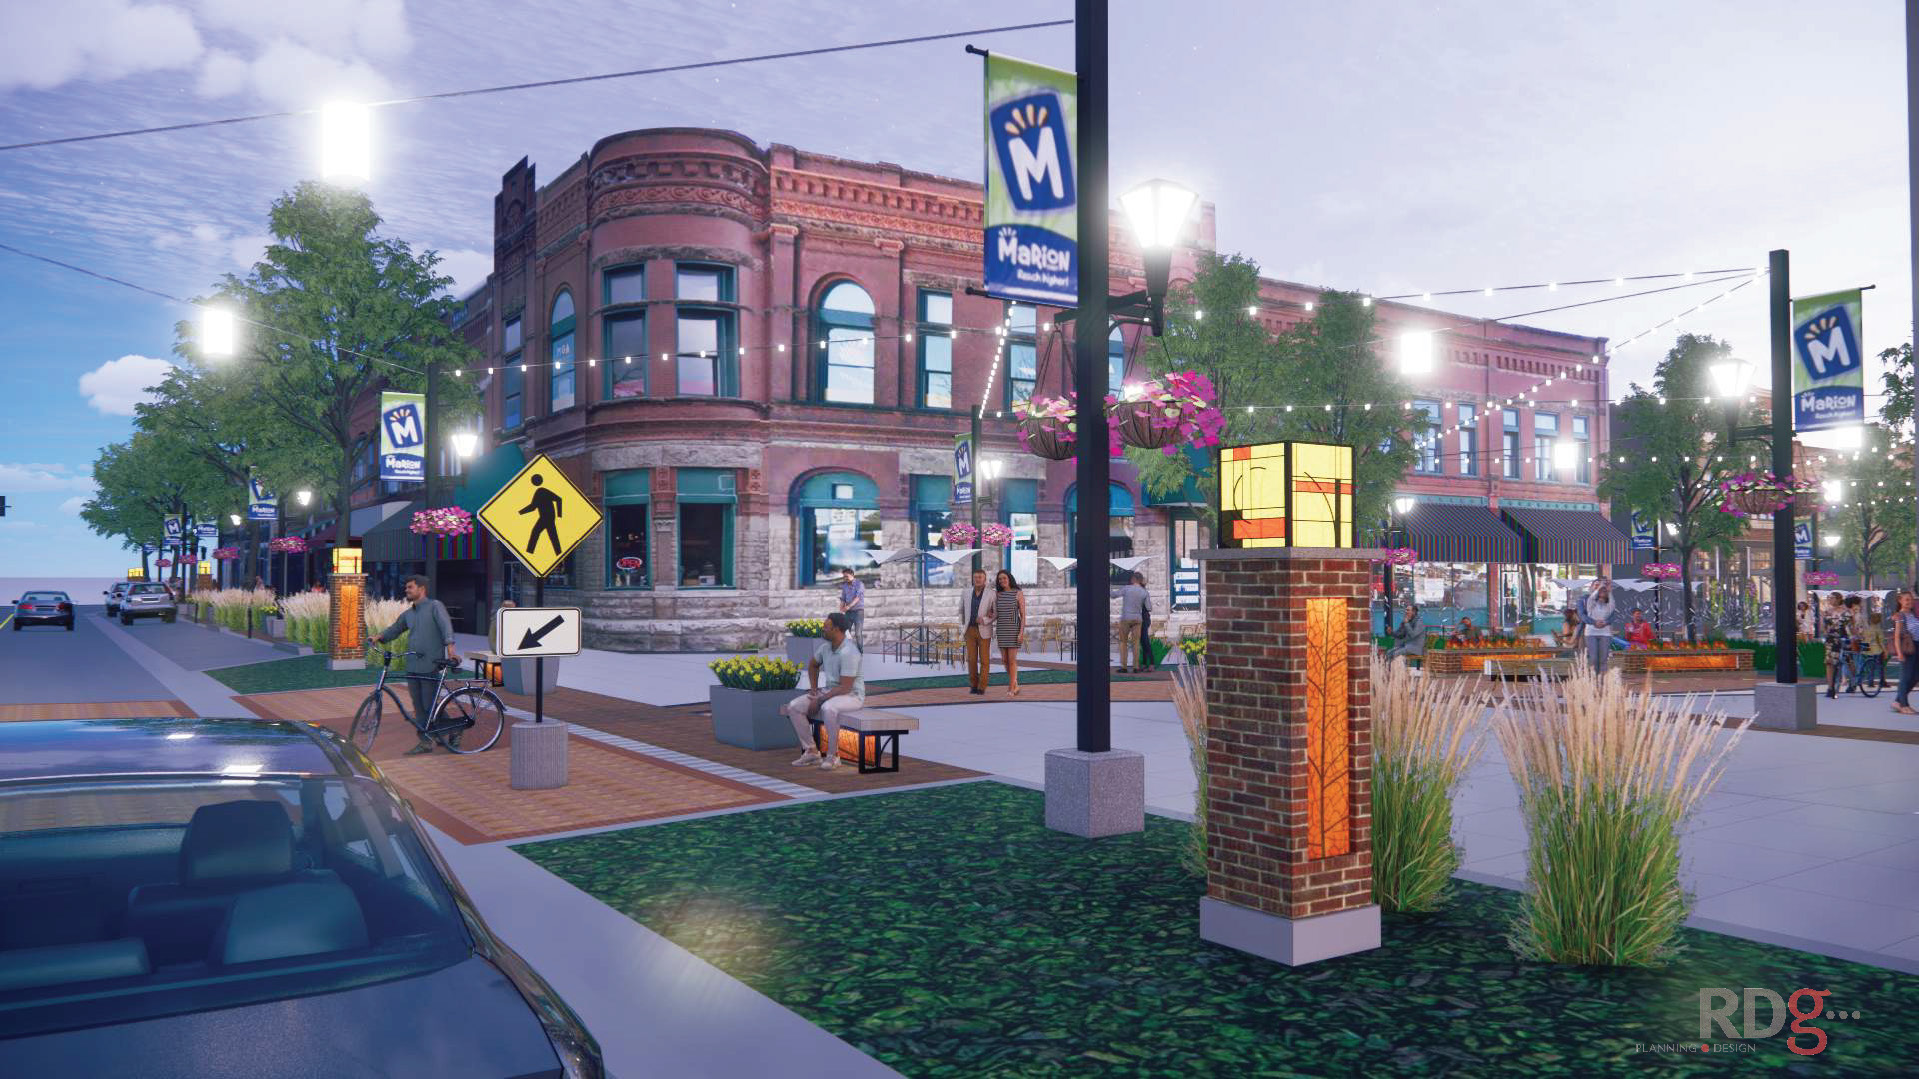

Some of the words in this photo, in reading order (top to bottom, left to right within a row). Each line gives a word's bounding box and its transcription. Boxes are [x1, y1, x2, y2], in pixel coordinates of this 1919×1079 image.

[1008, 126, 1064, 201] M
[1807, 326, 1851, 374] M
[391, 416, 419, 445] M
[958, 451, 969, 475] M
[168, 523, 180, 534] M
[1795, 529, 1808, 543] M
